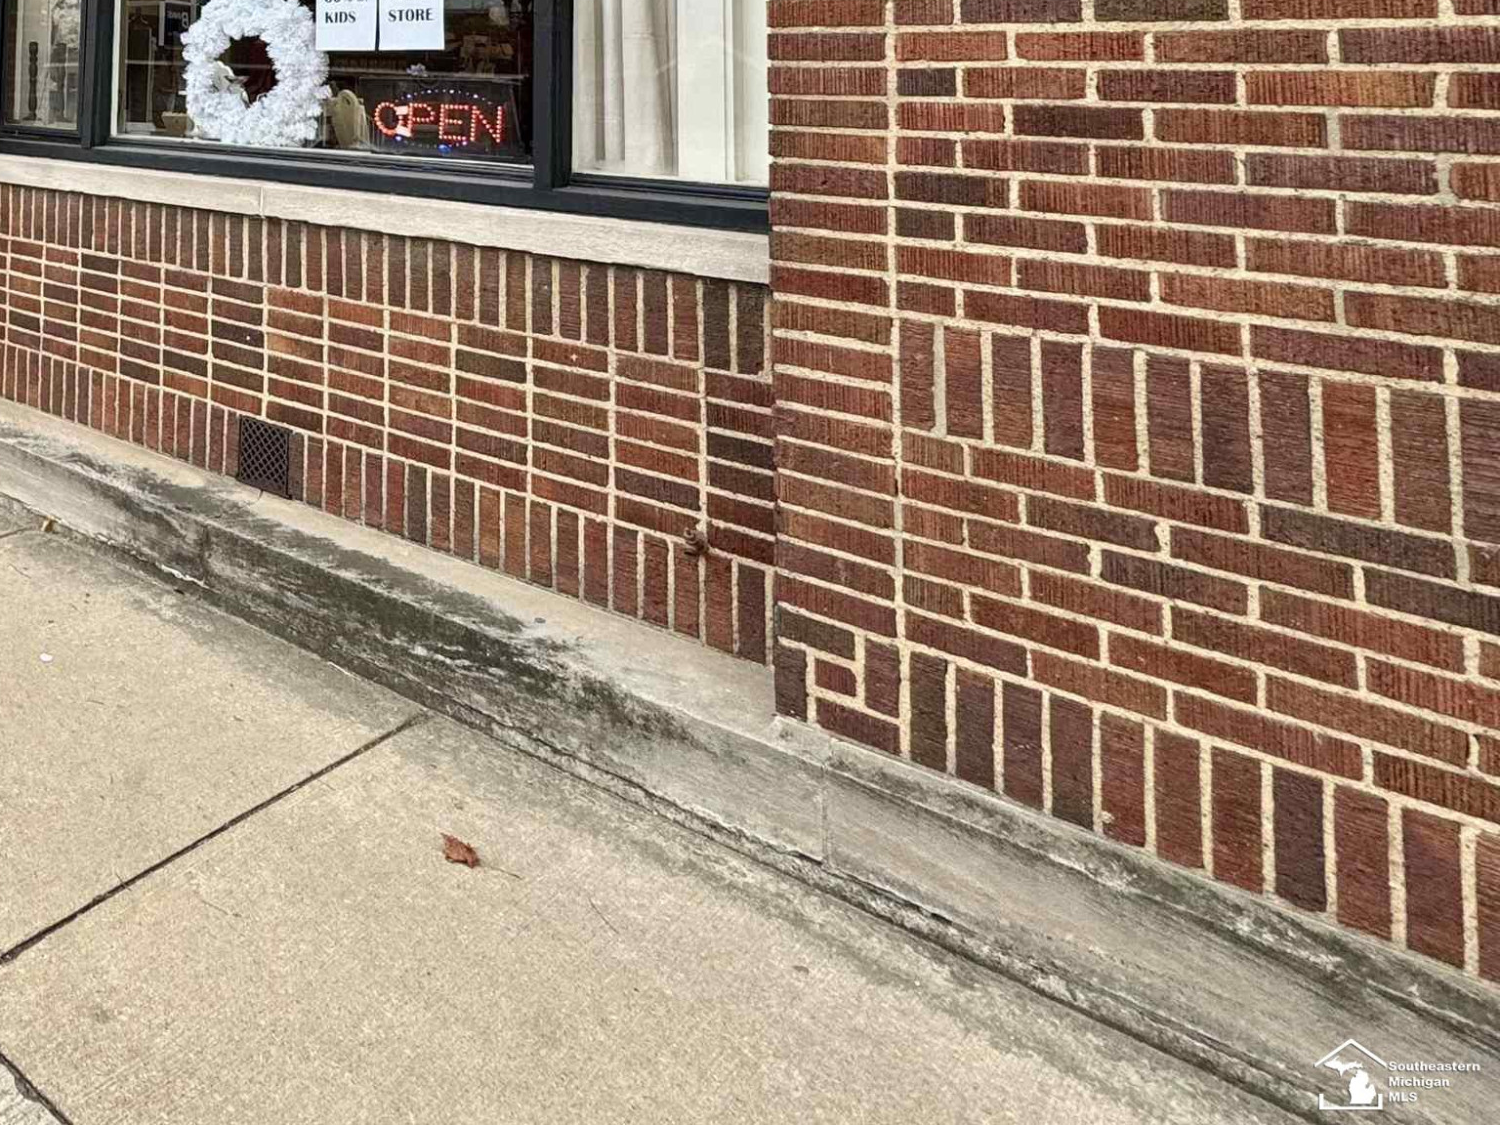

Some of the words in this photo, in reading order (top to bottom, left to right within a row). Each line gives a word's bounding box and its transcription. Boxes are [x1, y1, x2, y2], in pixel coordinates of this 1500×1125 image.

[325, 11, 356, 24] KIDS
[388, 8, 435, 22] STORE
[374, 102, 502, 143] OPEN
